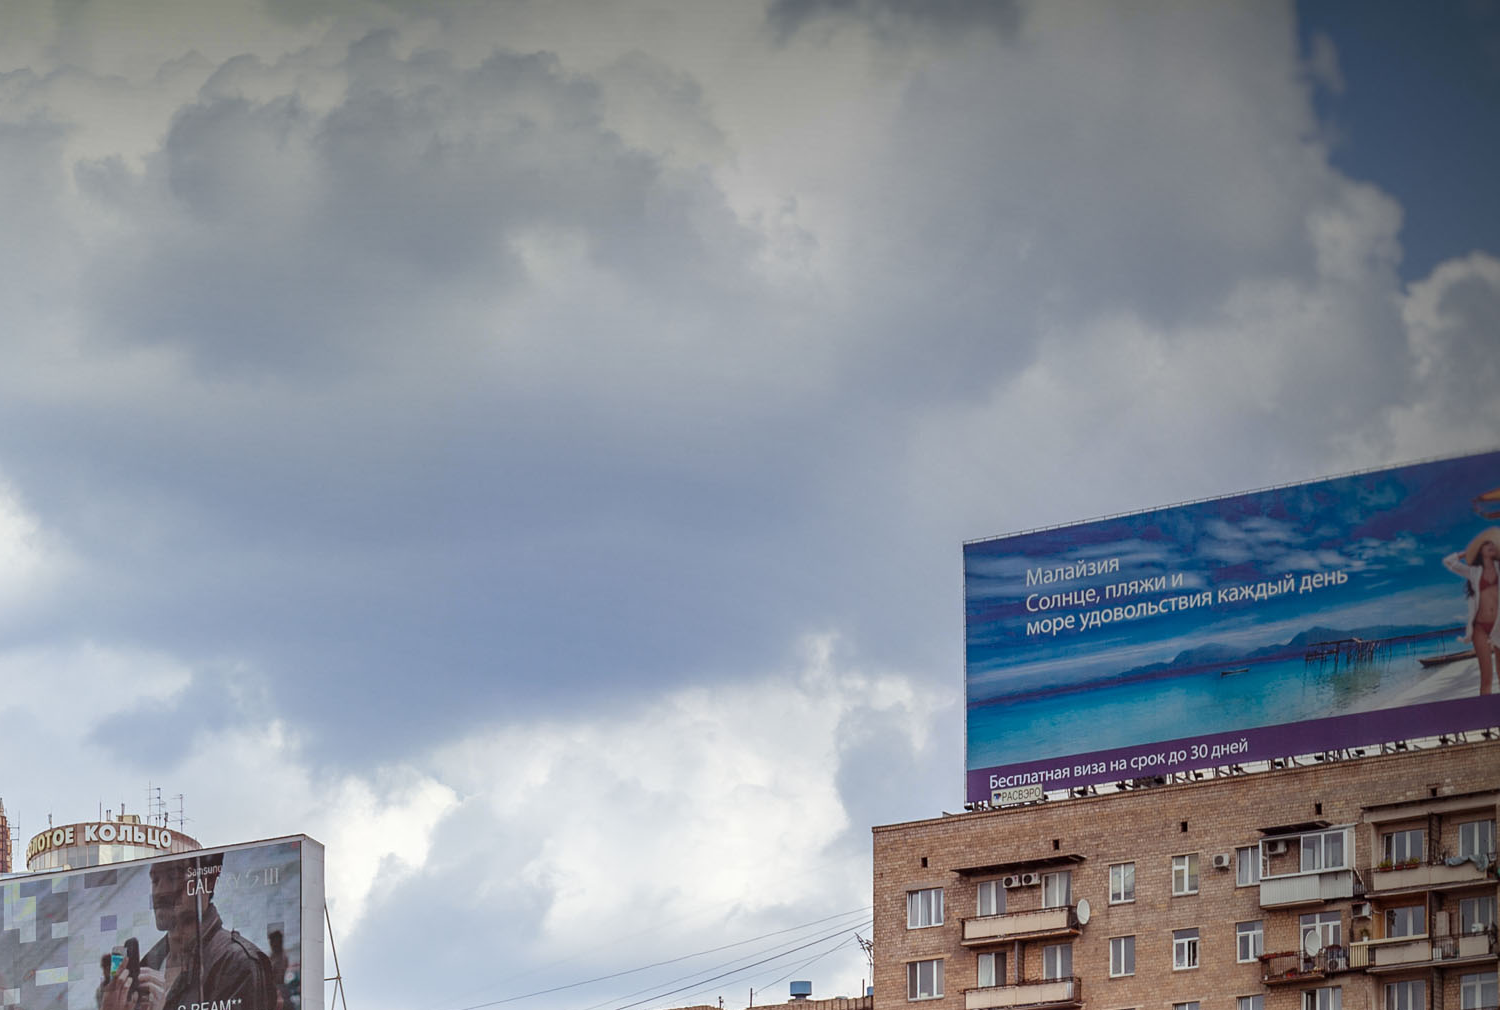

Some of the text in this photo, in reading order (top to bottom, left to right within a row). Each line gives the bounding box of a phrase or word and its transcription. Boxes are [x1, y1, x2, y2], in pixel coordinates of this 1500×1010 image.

[1025, 557, 1120, 587] Малайзия
[1025, 573, 1184, 613] Солнце, пляжи и
[1025, 568, 1349, 637] море удовольствия каждый день
[989, 738, 1250, 789] Бесплатная виза на срок до 30 дней
[1001, 786, 1041, 802] РАСВЭРО
[85, 824, 173, 849] КОЛЬЦО
